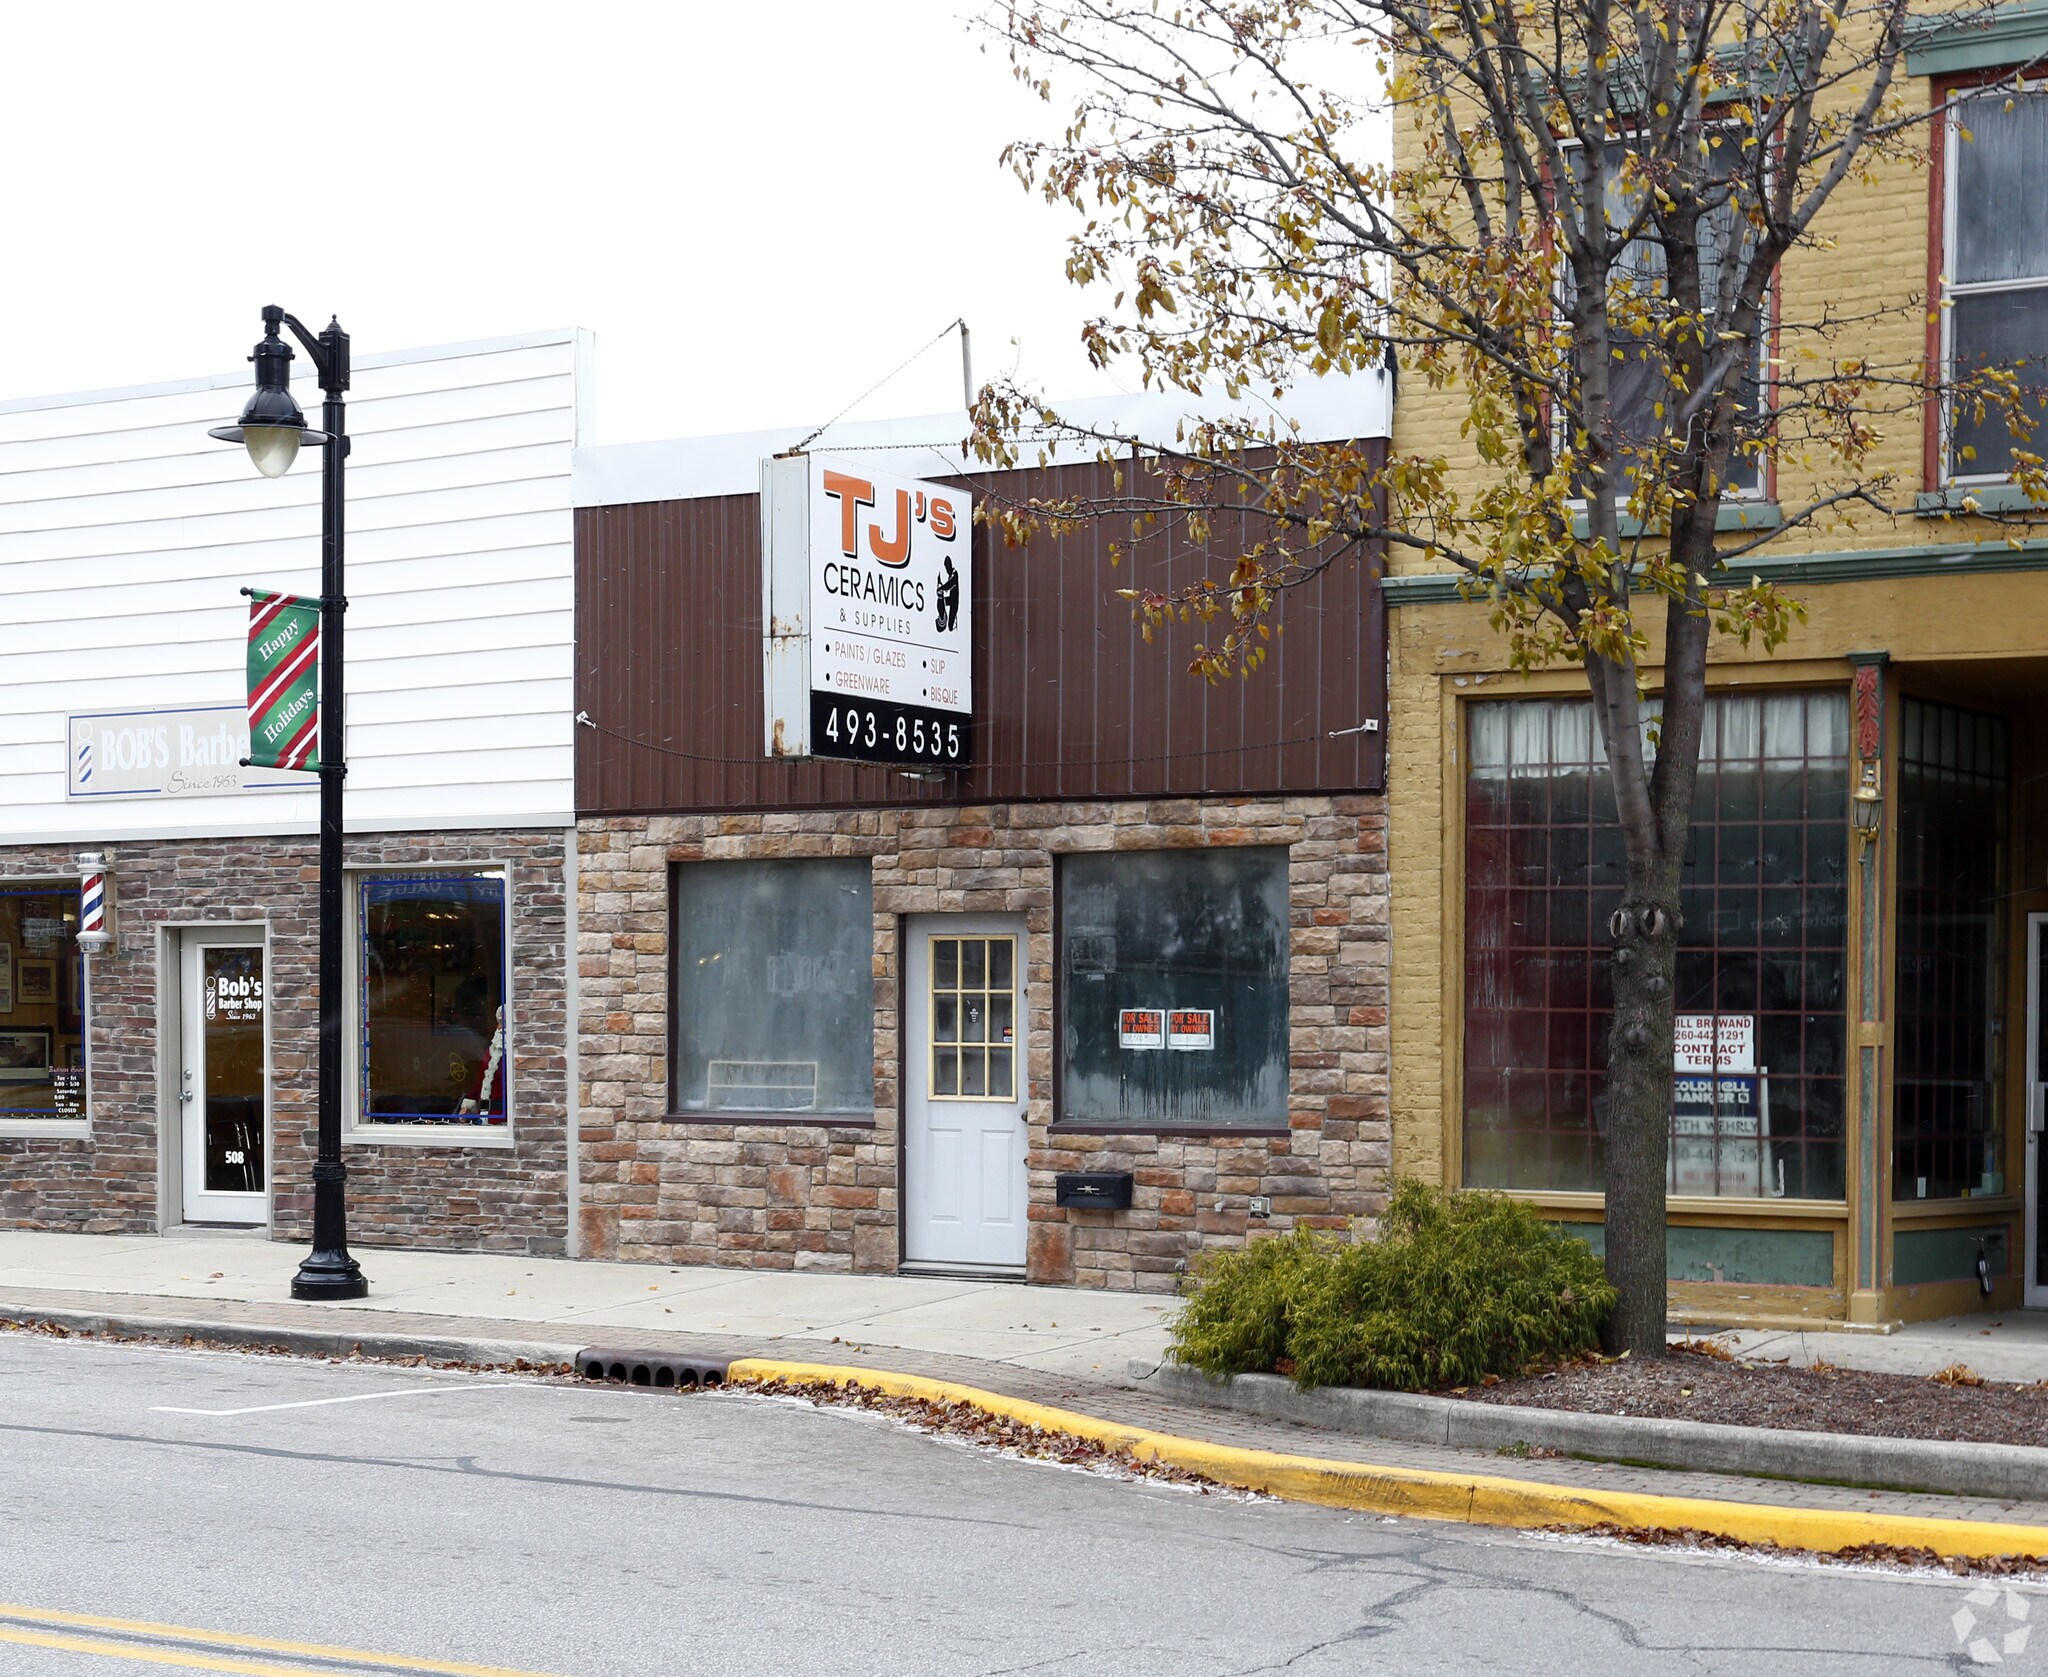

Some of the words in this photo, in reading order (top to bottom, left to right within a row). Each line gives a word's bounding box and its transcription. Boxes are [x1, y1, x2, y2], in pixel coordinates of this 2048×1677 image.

[823, 562, 925, 612] CERAMICS
[839, 608, 847, 623] &
[854, 611, 911, 635] SUPPLIES
[258, 618, 300, 662] Happy
[834, 641, 865, 662] PAINTS
[873, 649, 906, 669] GLAZES
[930, 658, 946, 674] SLIP
[835, 671, 890, 694] GREENWARE
[930, 687, 958, 705] BISQUE
[263, 688, 314, 745] Holidays
[825, 707, 959, 759] 493-8535
[101, 726, 170, 771] BOB'S
[179, 722, 250, 767] Barbe
[167, 770, 210, 794] Since
[212, 775, 237, 788] 1963
[218, 976, 262, 996] Bob's
[218, 997, 243, 1009] Barber
[244, 997, 262, 1012] Shop
[226, 1010, 241, 1020] Since
[1123, 1013, 1136, 1023] FOR
[1138, 1013, 1160, 1023] SALE
[1171, 1013, 1184, 1023] FOR
[1187, 1013, 1209, 1024] SALE
[1123, 1023, 1131, 1033] BY
[1132, 1024, 1159, 1033] OWNER
[1171, 1024, 1179, 1033] BY
[1181, 1025, 1209, 1033] OWNER
[1674, 1019, 1693, 1028] ILL
[1675, 1030, 1744, 1040] 260-442-1291
[1673, 1044, 1746, 1054] CONTRACT
[1686, 1055, 1732, 1065] TERMS
[225, 1151, 244, 1164] 508
